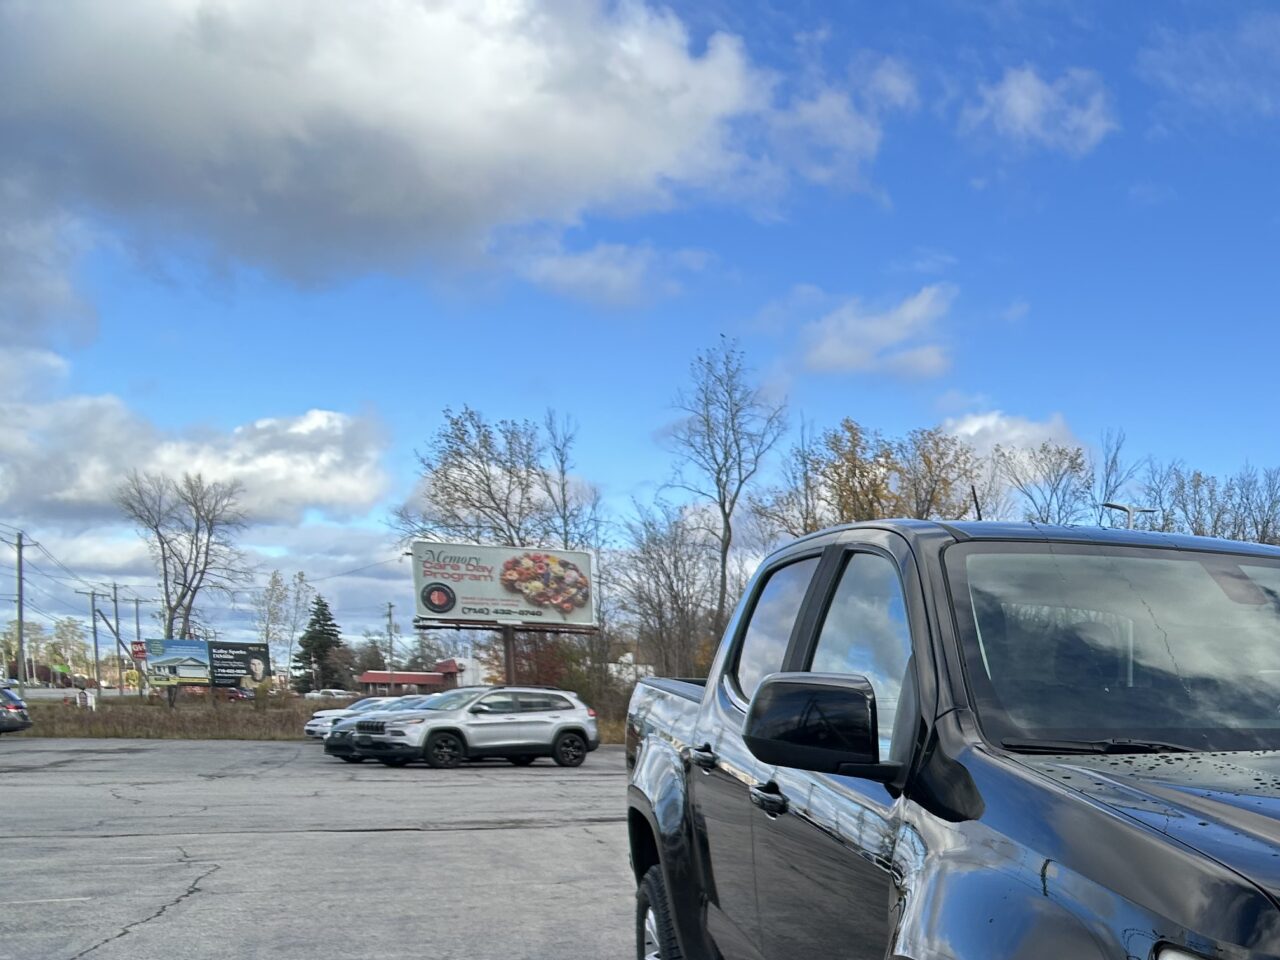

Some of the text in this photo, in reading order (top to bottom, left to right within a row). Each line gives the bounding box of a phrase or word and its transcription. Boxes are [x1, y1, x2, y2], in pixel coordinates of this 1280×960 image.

[423, 560, 494, 574] Care Day
[423, 570, 494, 583] Program
